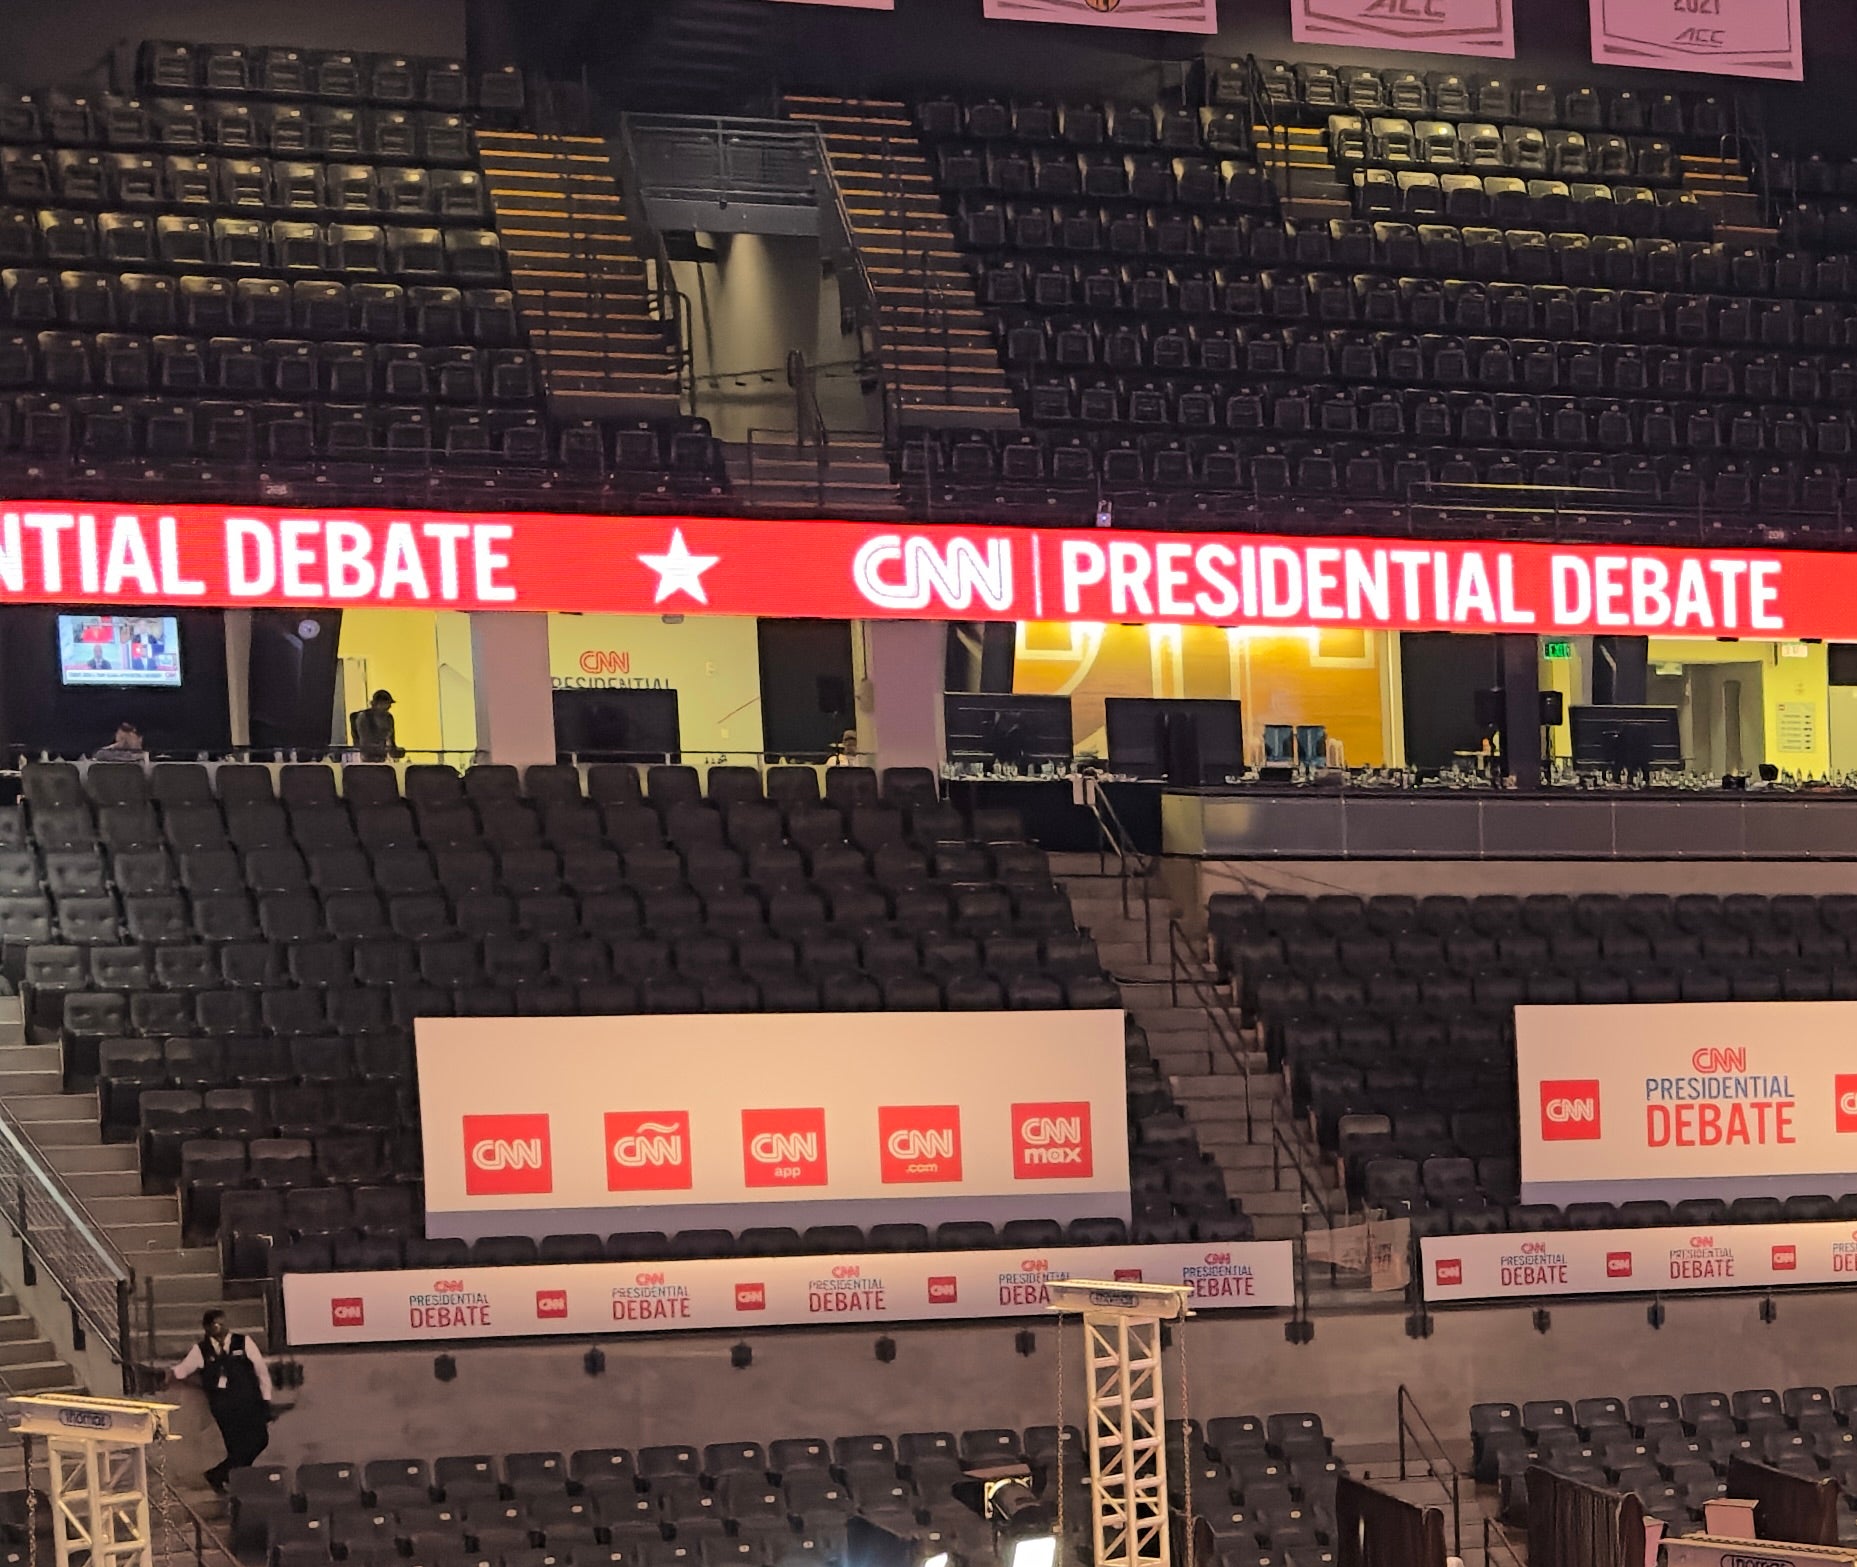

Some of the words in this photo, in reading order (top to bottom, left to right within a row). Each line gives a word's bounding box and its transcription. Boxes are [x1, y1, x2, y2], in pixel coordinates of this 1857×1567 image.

[225, 517, 517, 602] DEBATE
[853, 535, 1013, 610] CNN
[1061, 540, 1535, 626] PRESIDENTIAL
[1551, 554, 1785, 630] DEBATE
[580, 651, 630, 674] CNN
[1692, 1047, 1746, 1073] CNN
[1646, 1075, 1795, 1101] PRESIDENTIAL
[1546, 1098, 1593, 1122] CNN
[1021, 1117, 1080, 1146] CNN
[1646, 1101, 1796, 1147] DEBATE
[472, 1139, 542, 1170] CNN
[750, 1132, 818, 1163] CNN
[888, 1129, 953, 1159] CNN
[1024, 1148, 1081, 1164] max
[774, 1166, 802, 1180] app
[809, 1278, 883, 1291] PRESIDENTIAL
[809, 1289, 886, 1313] DEBATE
